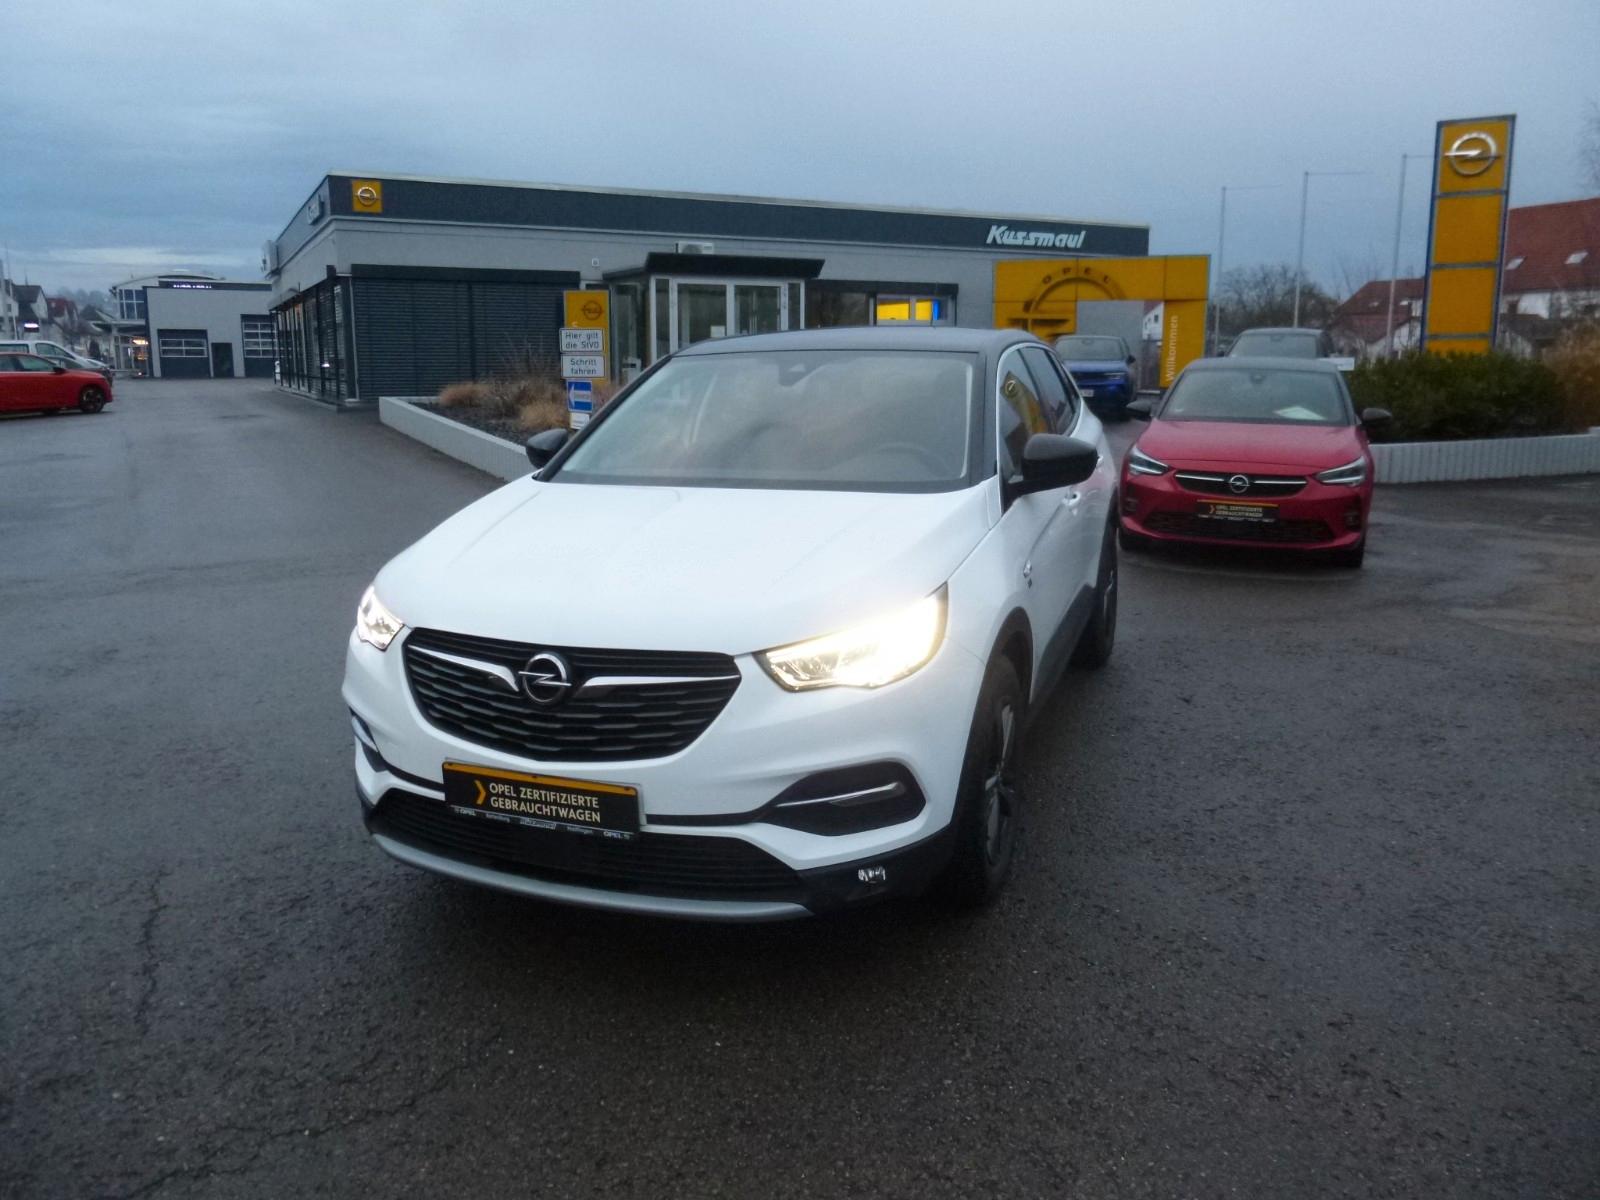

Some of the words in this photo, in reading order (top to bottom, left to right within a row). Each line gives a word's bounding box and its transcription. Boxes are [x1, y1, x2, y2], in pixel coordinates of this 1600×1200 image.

[986, 225, 1086, 248] Kussmaul
[565, 332, 582, 340] Hier
[565, 341, 578, 349] die
[1166, 315, 1178, 381] Willkommen
[570, 367, 597, 375] fahren
[489, 782, 517, 798] OPEL
[519, 786, 600, 809] ZERTIFIZIERTE
[490, 796, 601, 823] GEBRAUCHTWAGEN
